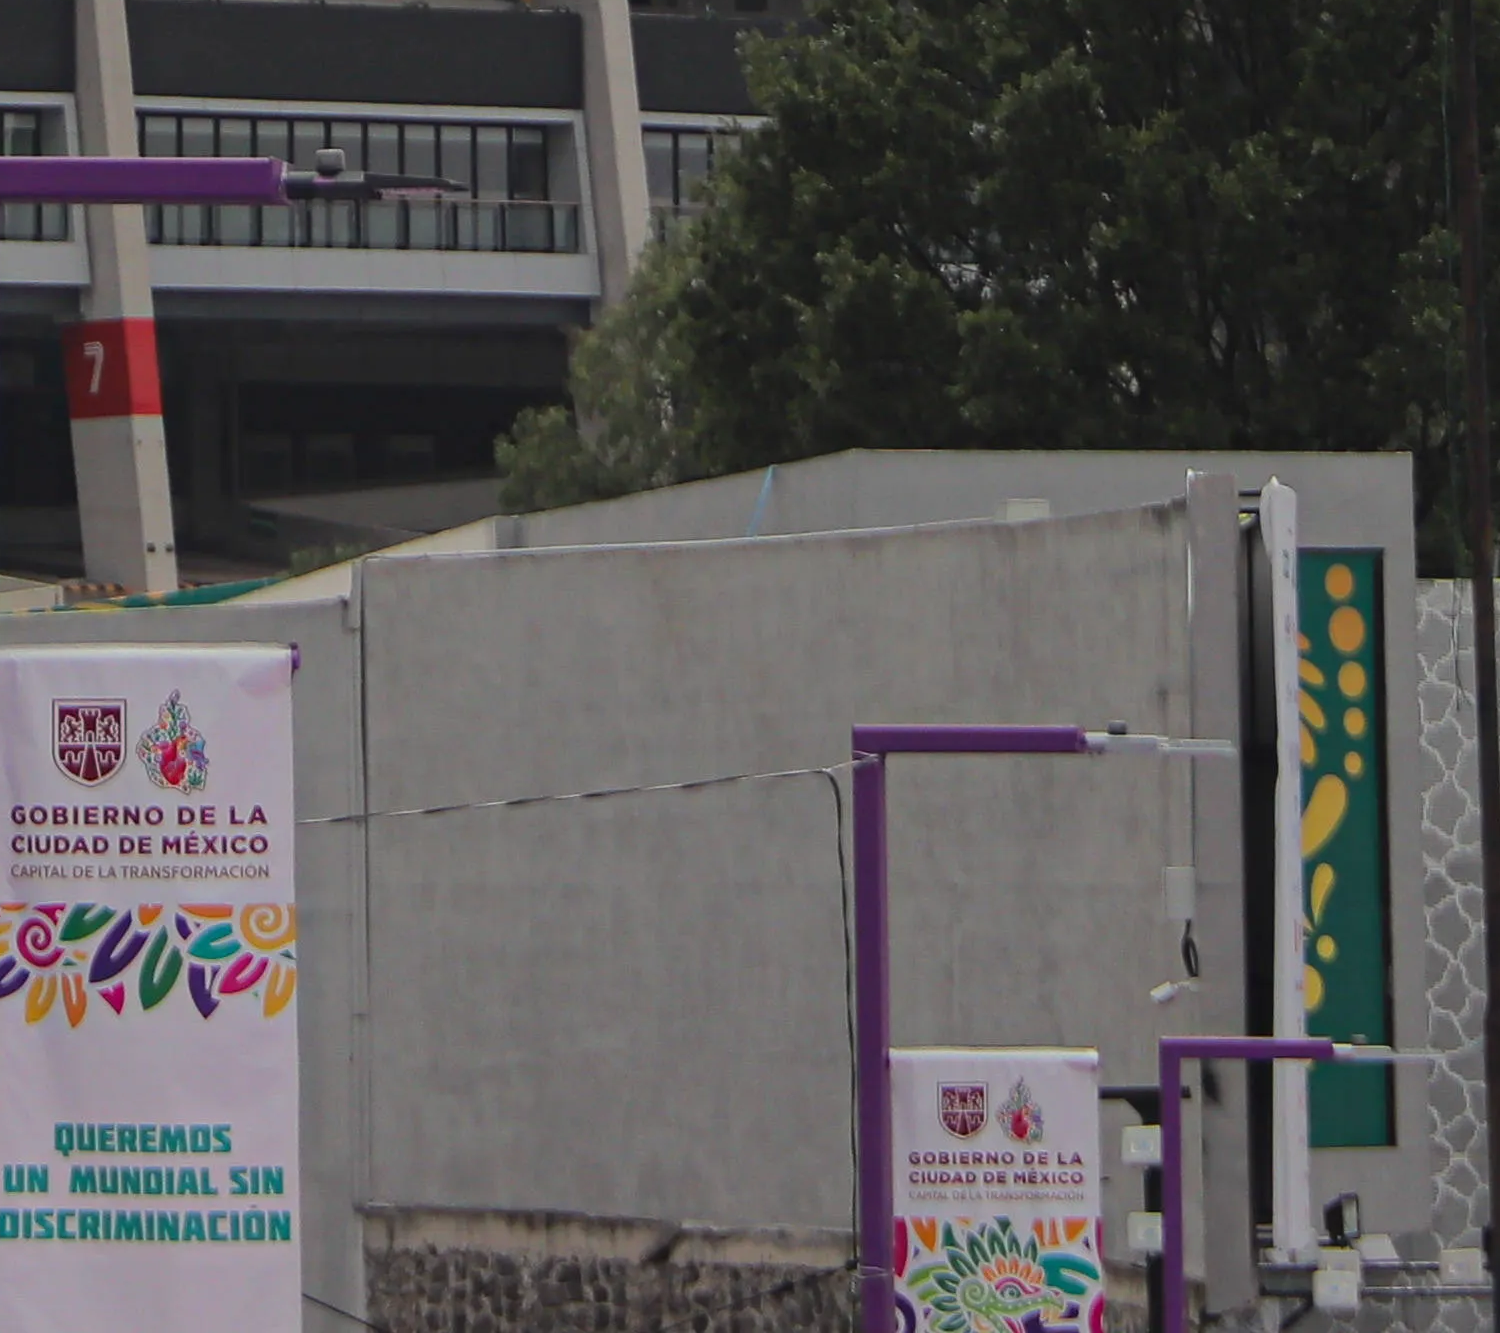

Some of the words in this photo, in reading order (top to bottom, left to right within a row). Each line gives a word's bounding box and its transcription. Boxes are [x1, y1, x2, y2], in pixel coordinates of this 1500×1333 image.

[83, 340, 104, 395] 7
[10, 805, 165, 826] GOBIERNO
[177, 805, 216, 826] DE
[229, 805, 269, 826] LA
[10, 835, 110, 855] CIUDAD
[119, 835, 152, 855] DE
[162, 830, 270, 855] MÉXICO
[10, 864, 68, 879] CAPITAL
[73, 864, 94, 879] DE
[98, 864, 117, 879] LA
[53, 1122, 232, 1157] QUEREMOS
[908, 1151, 1015, 1166] GOBIERNO
[1022, 1151, 1049, 1166] DE
[1057, 1151, 1083, 1166] LA
[3, 1164, 49, 1194] UN
[69, 1166, 219, 1196] MUNDIAL
[229, 1166, 285, 1196] SIN
[908, 1171, 977, 1185] CIUDAD
[983, 1171, 1007, 1185] DE
[1013, 1168, 1084, 1185] MÉXICO
